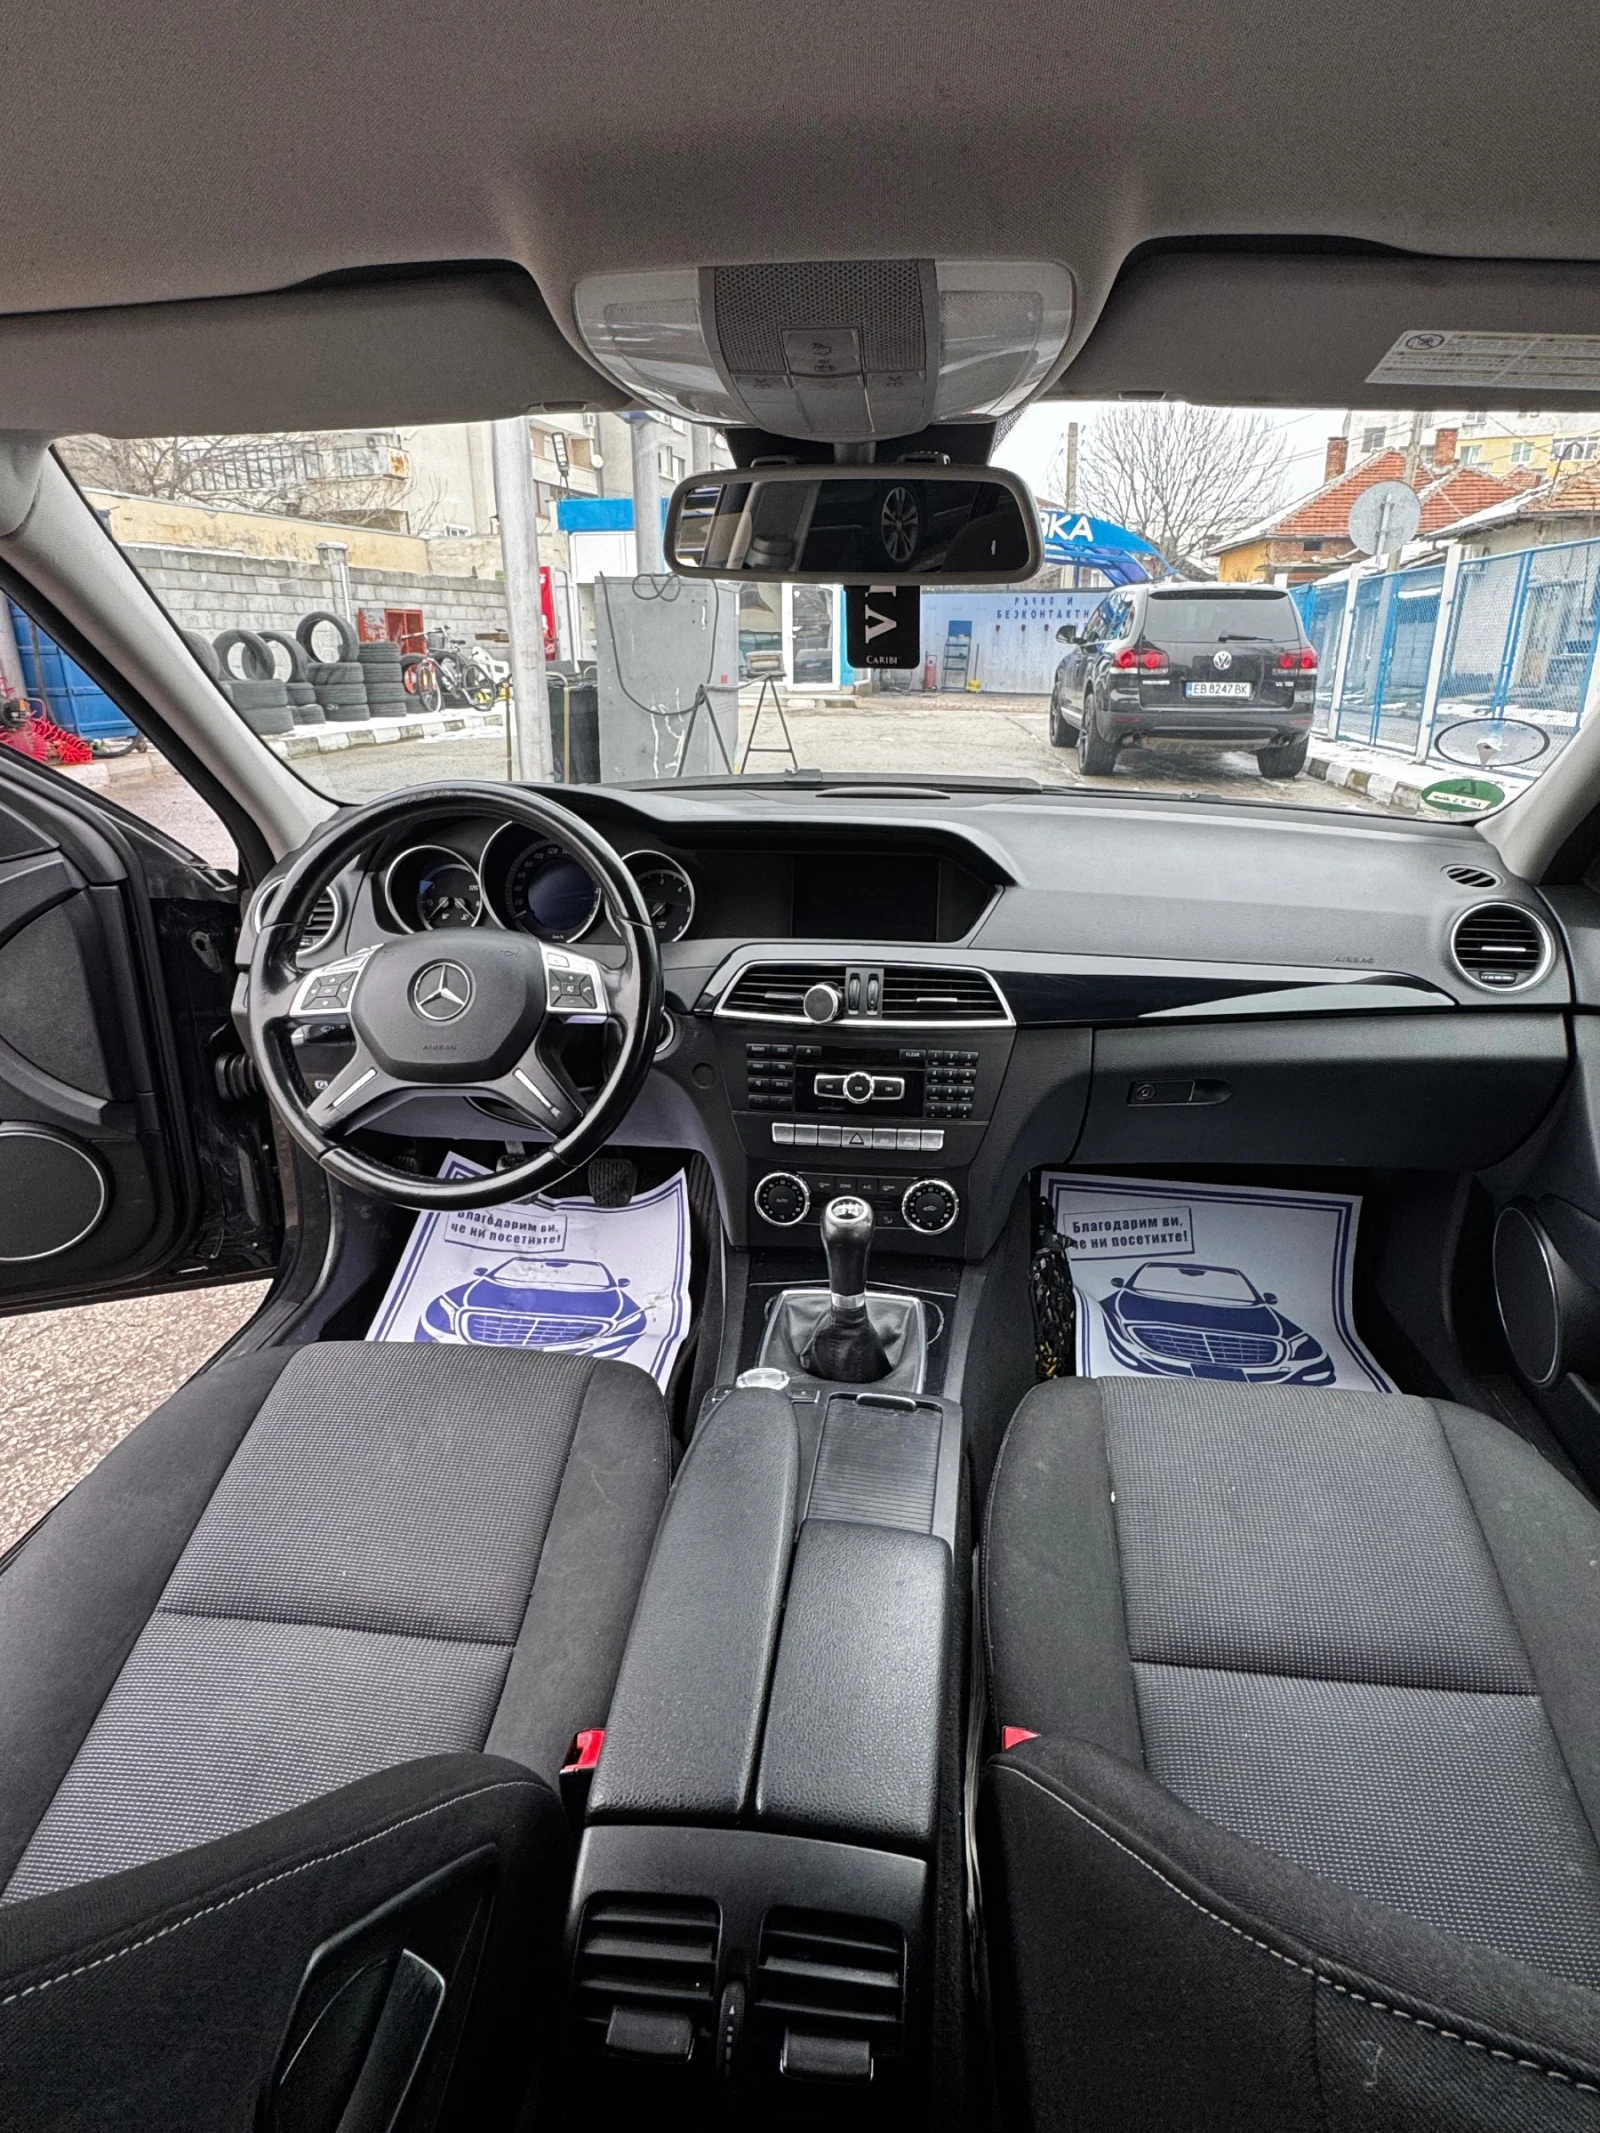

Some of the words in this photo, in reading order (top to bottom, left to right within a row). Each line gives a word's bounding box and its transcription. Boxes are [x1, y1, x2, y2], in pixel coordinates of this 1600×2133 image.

[1014, 596, 1055, 606] РЪЧНО
[1067, 596, 1073, 606] И
[1208, 683, 1233, 695] 8247
[451, 1222, 466, 1234] че
[469, 1226, 486, 1239] ни
[1072, 1217, 1158, 1234] Благодарим
[1091, 1238, 1108, 1249] ни
[1112, 1230, 1188, 1247] посетихте!
